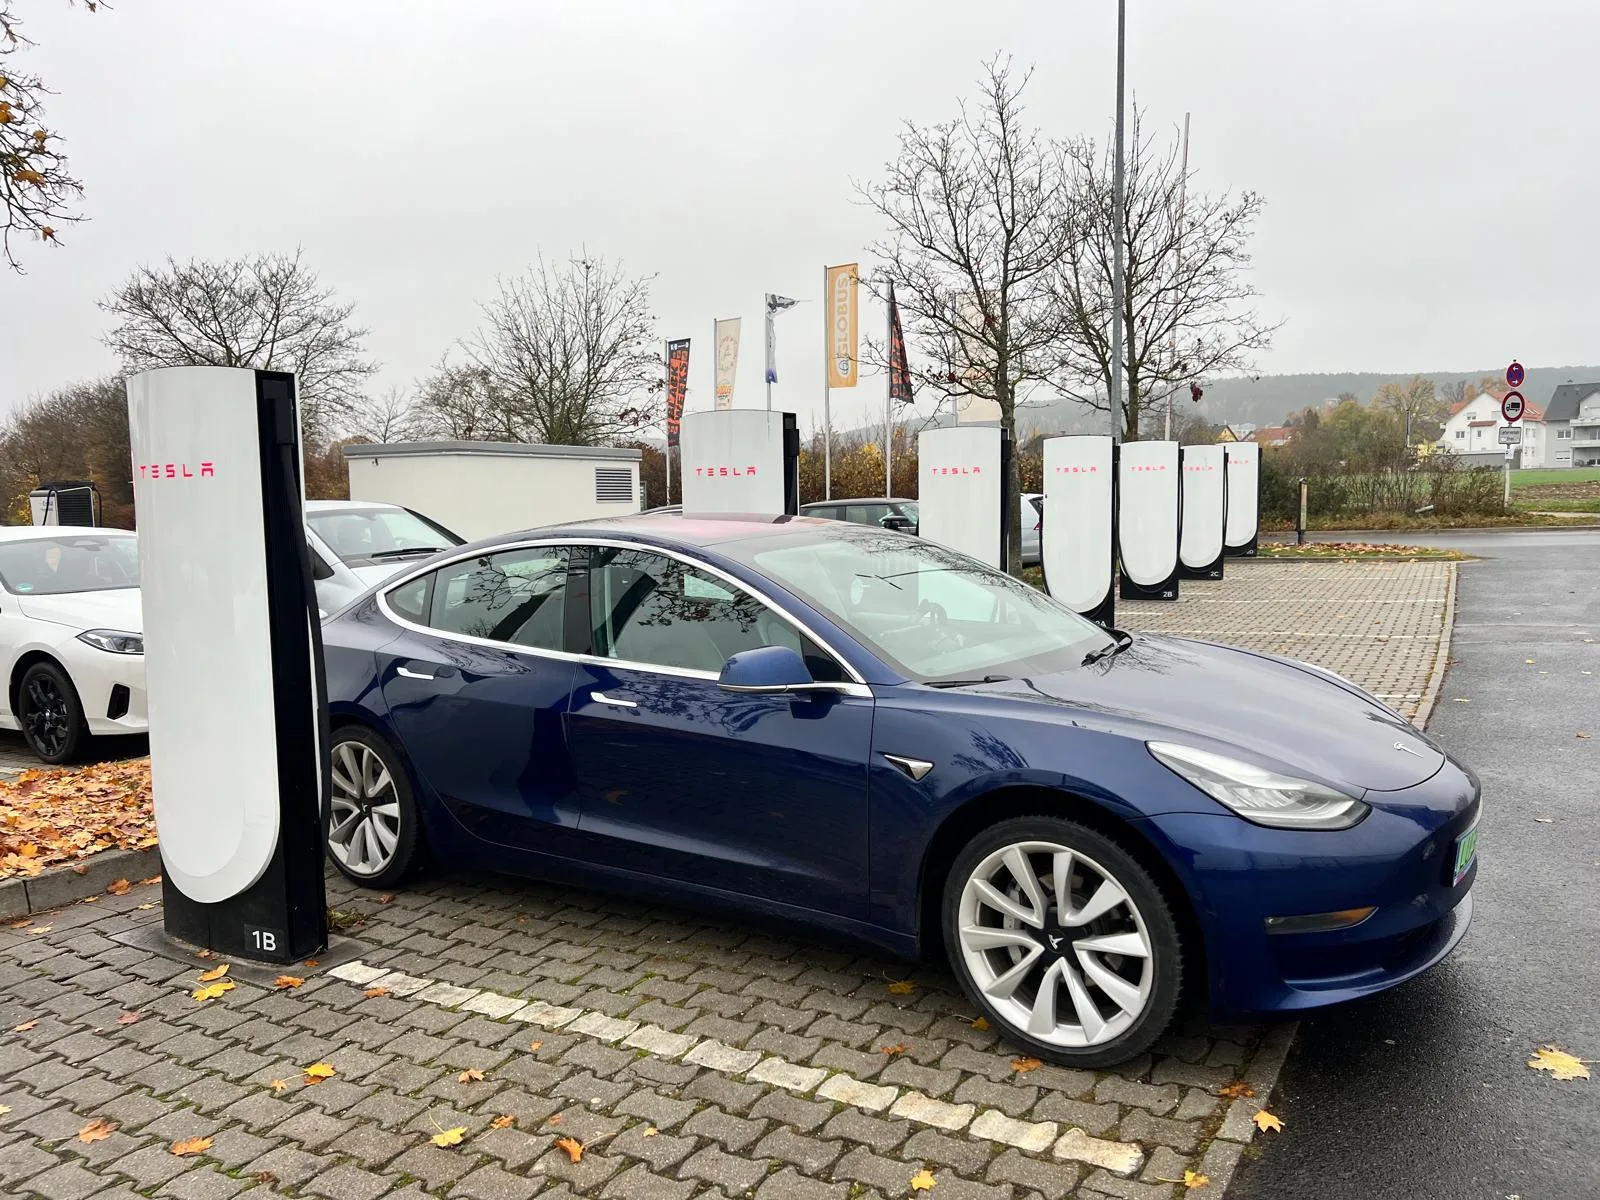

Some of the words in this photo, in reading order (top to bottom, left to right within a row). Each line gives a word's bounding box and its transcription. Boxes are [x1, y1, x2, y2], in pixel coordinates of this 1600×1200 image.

[837, 278, 848, 354] GLOBUS
[140, 462, 214, 479] TESLA
[696, 466, 756, 477] TESLA
[932, 466, 981, 475] TESLA
[252, 930, 276, 951] 1B
